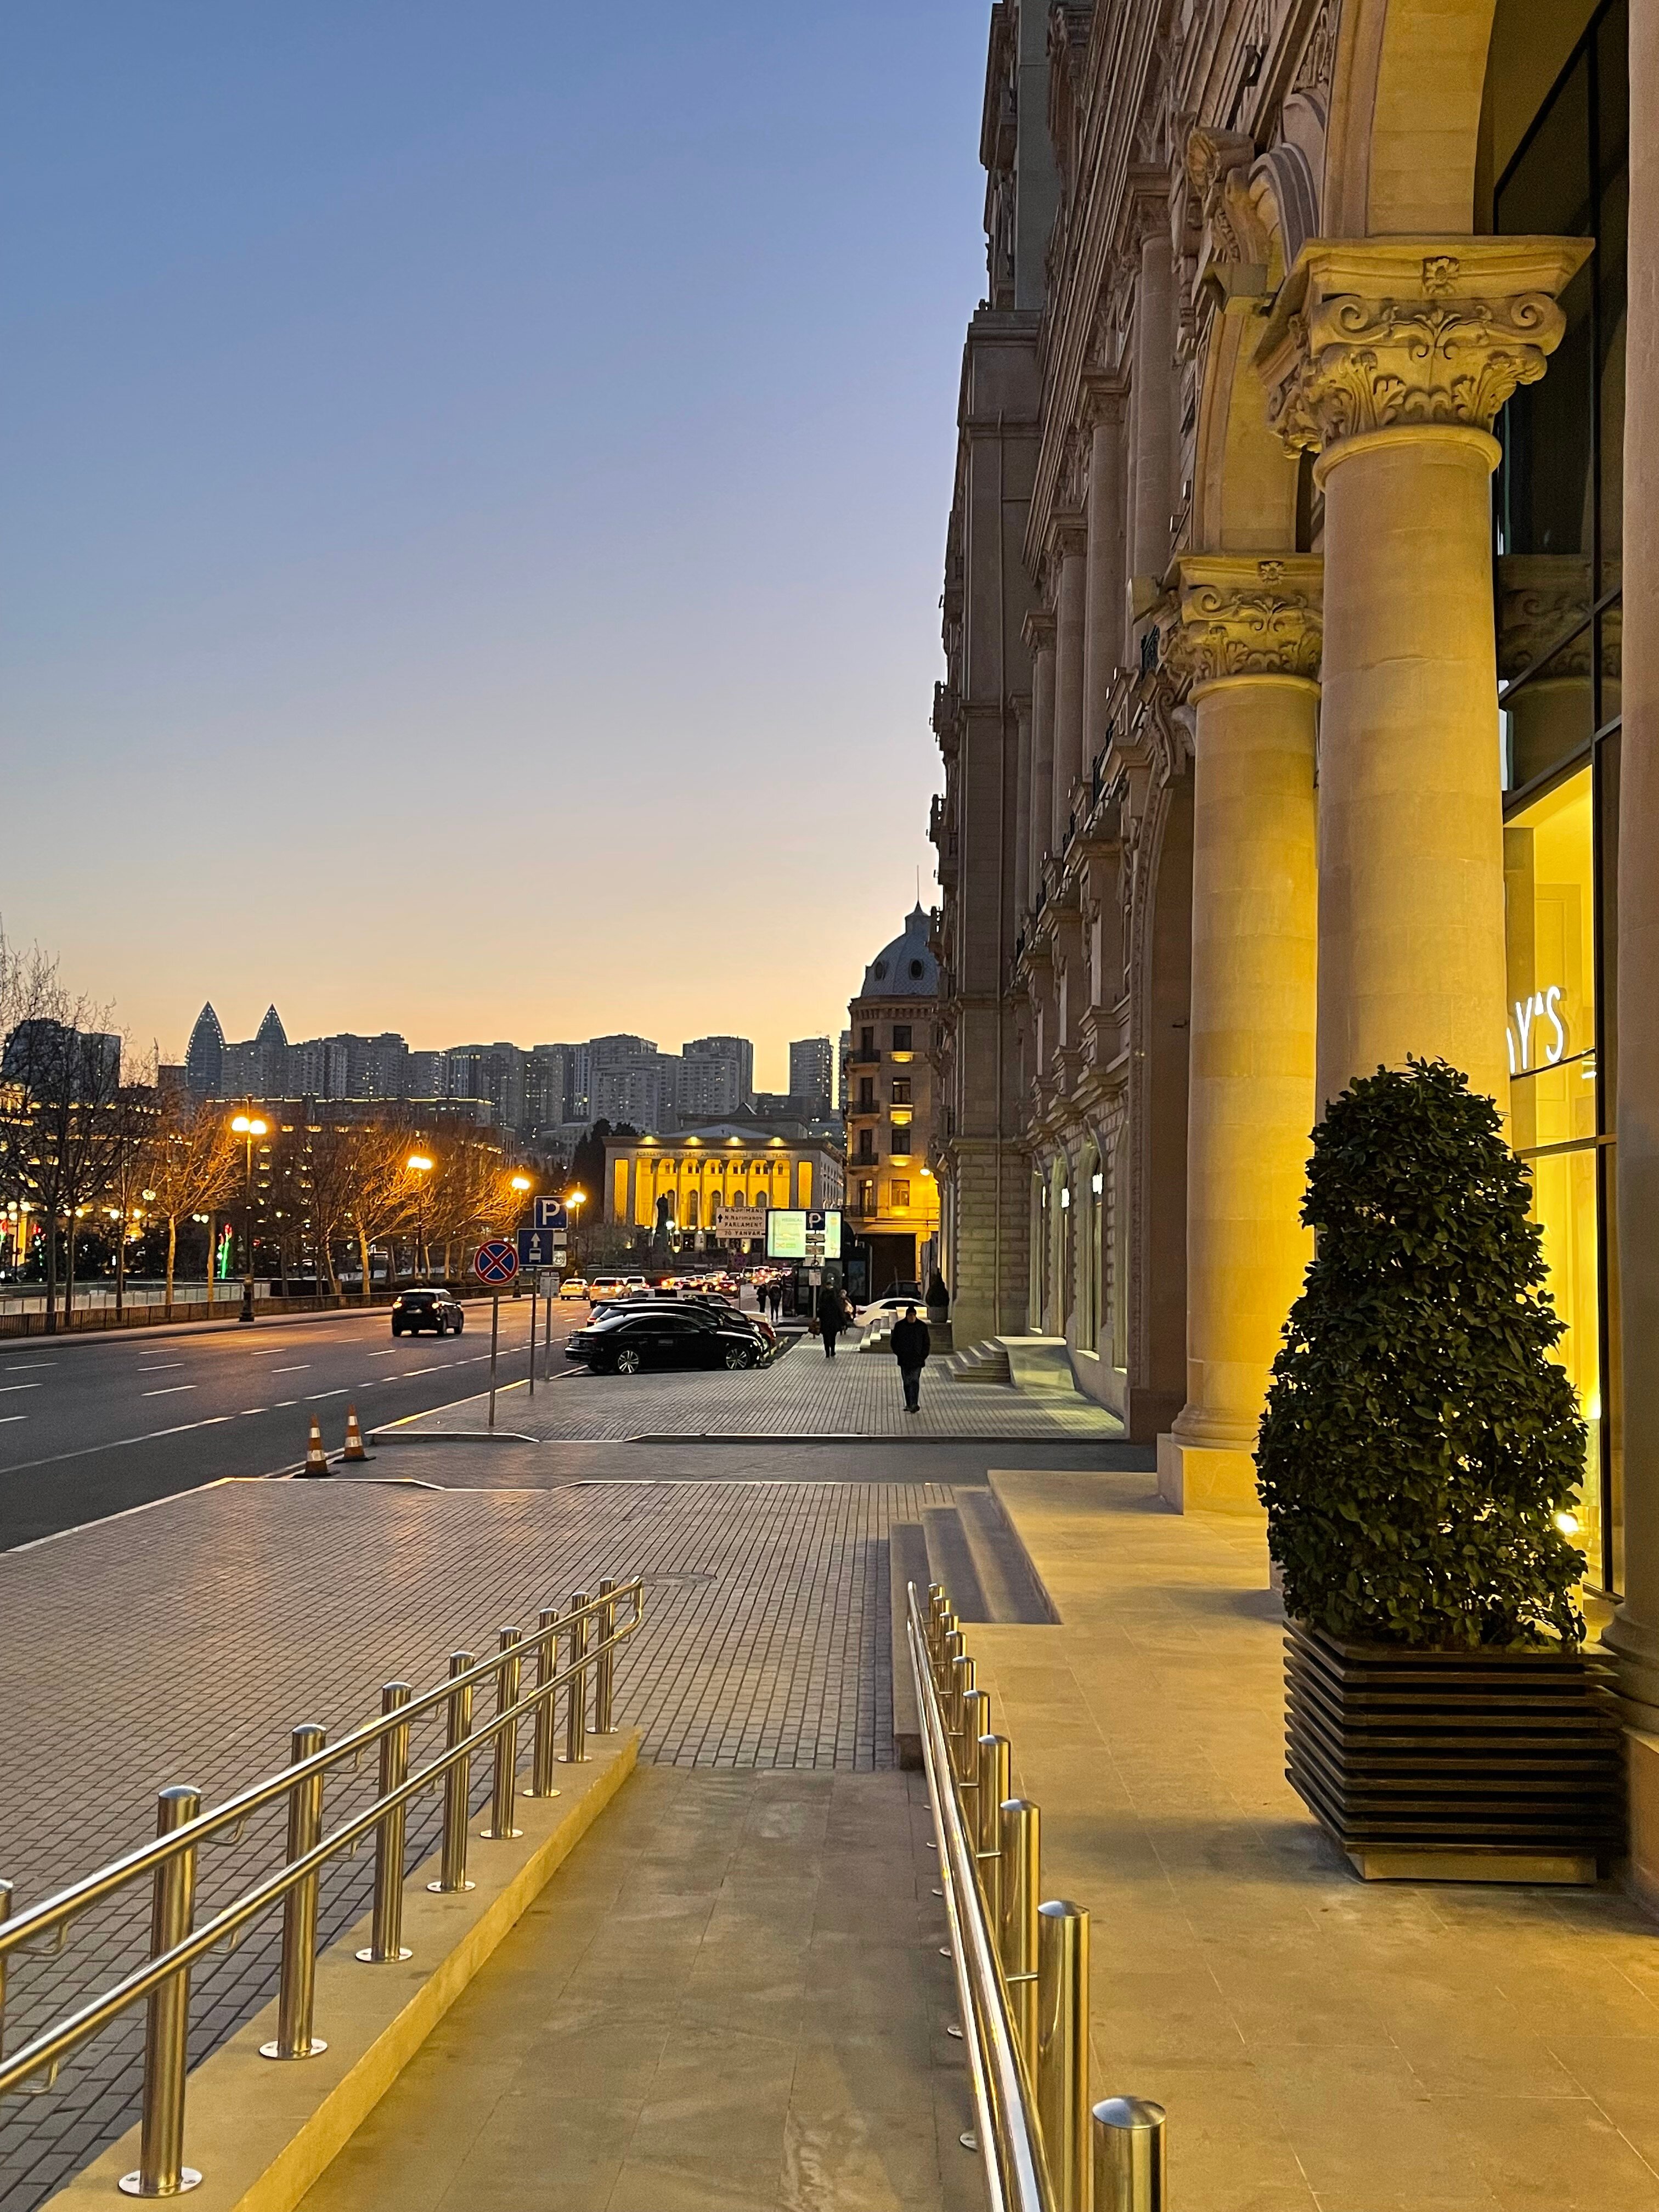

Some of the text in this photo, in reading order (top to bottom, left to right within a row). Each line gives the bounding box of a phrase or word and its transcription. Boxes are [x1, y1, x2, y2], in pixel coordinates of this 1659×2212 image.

[1506, 986, 1564, 1074] Y'S
[541, 1200, 560, 1226] P
[809, 1212, 822, 1229] P
